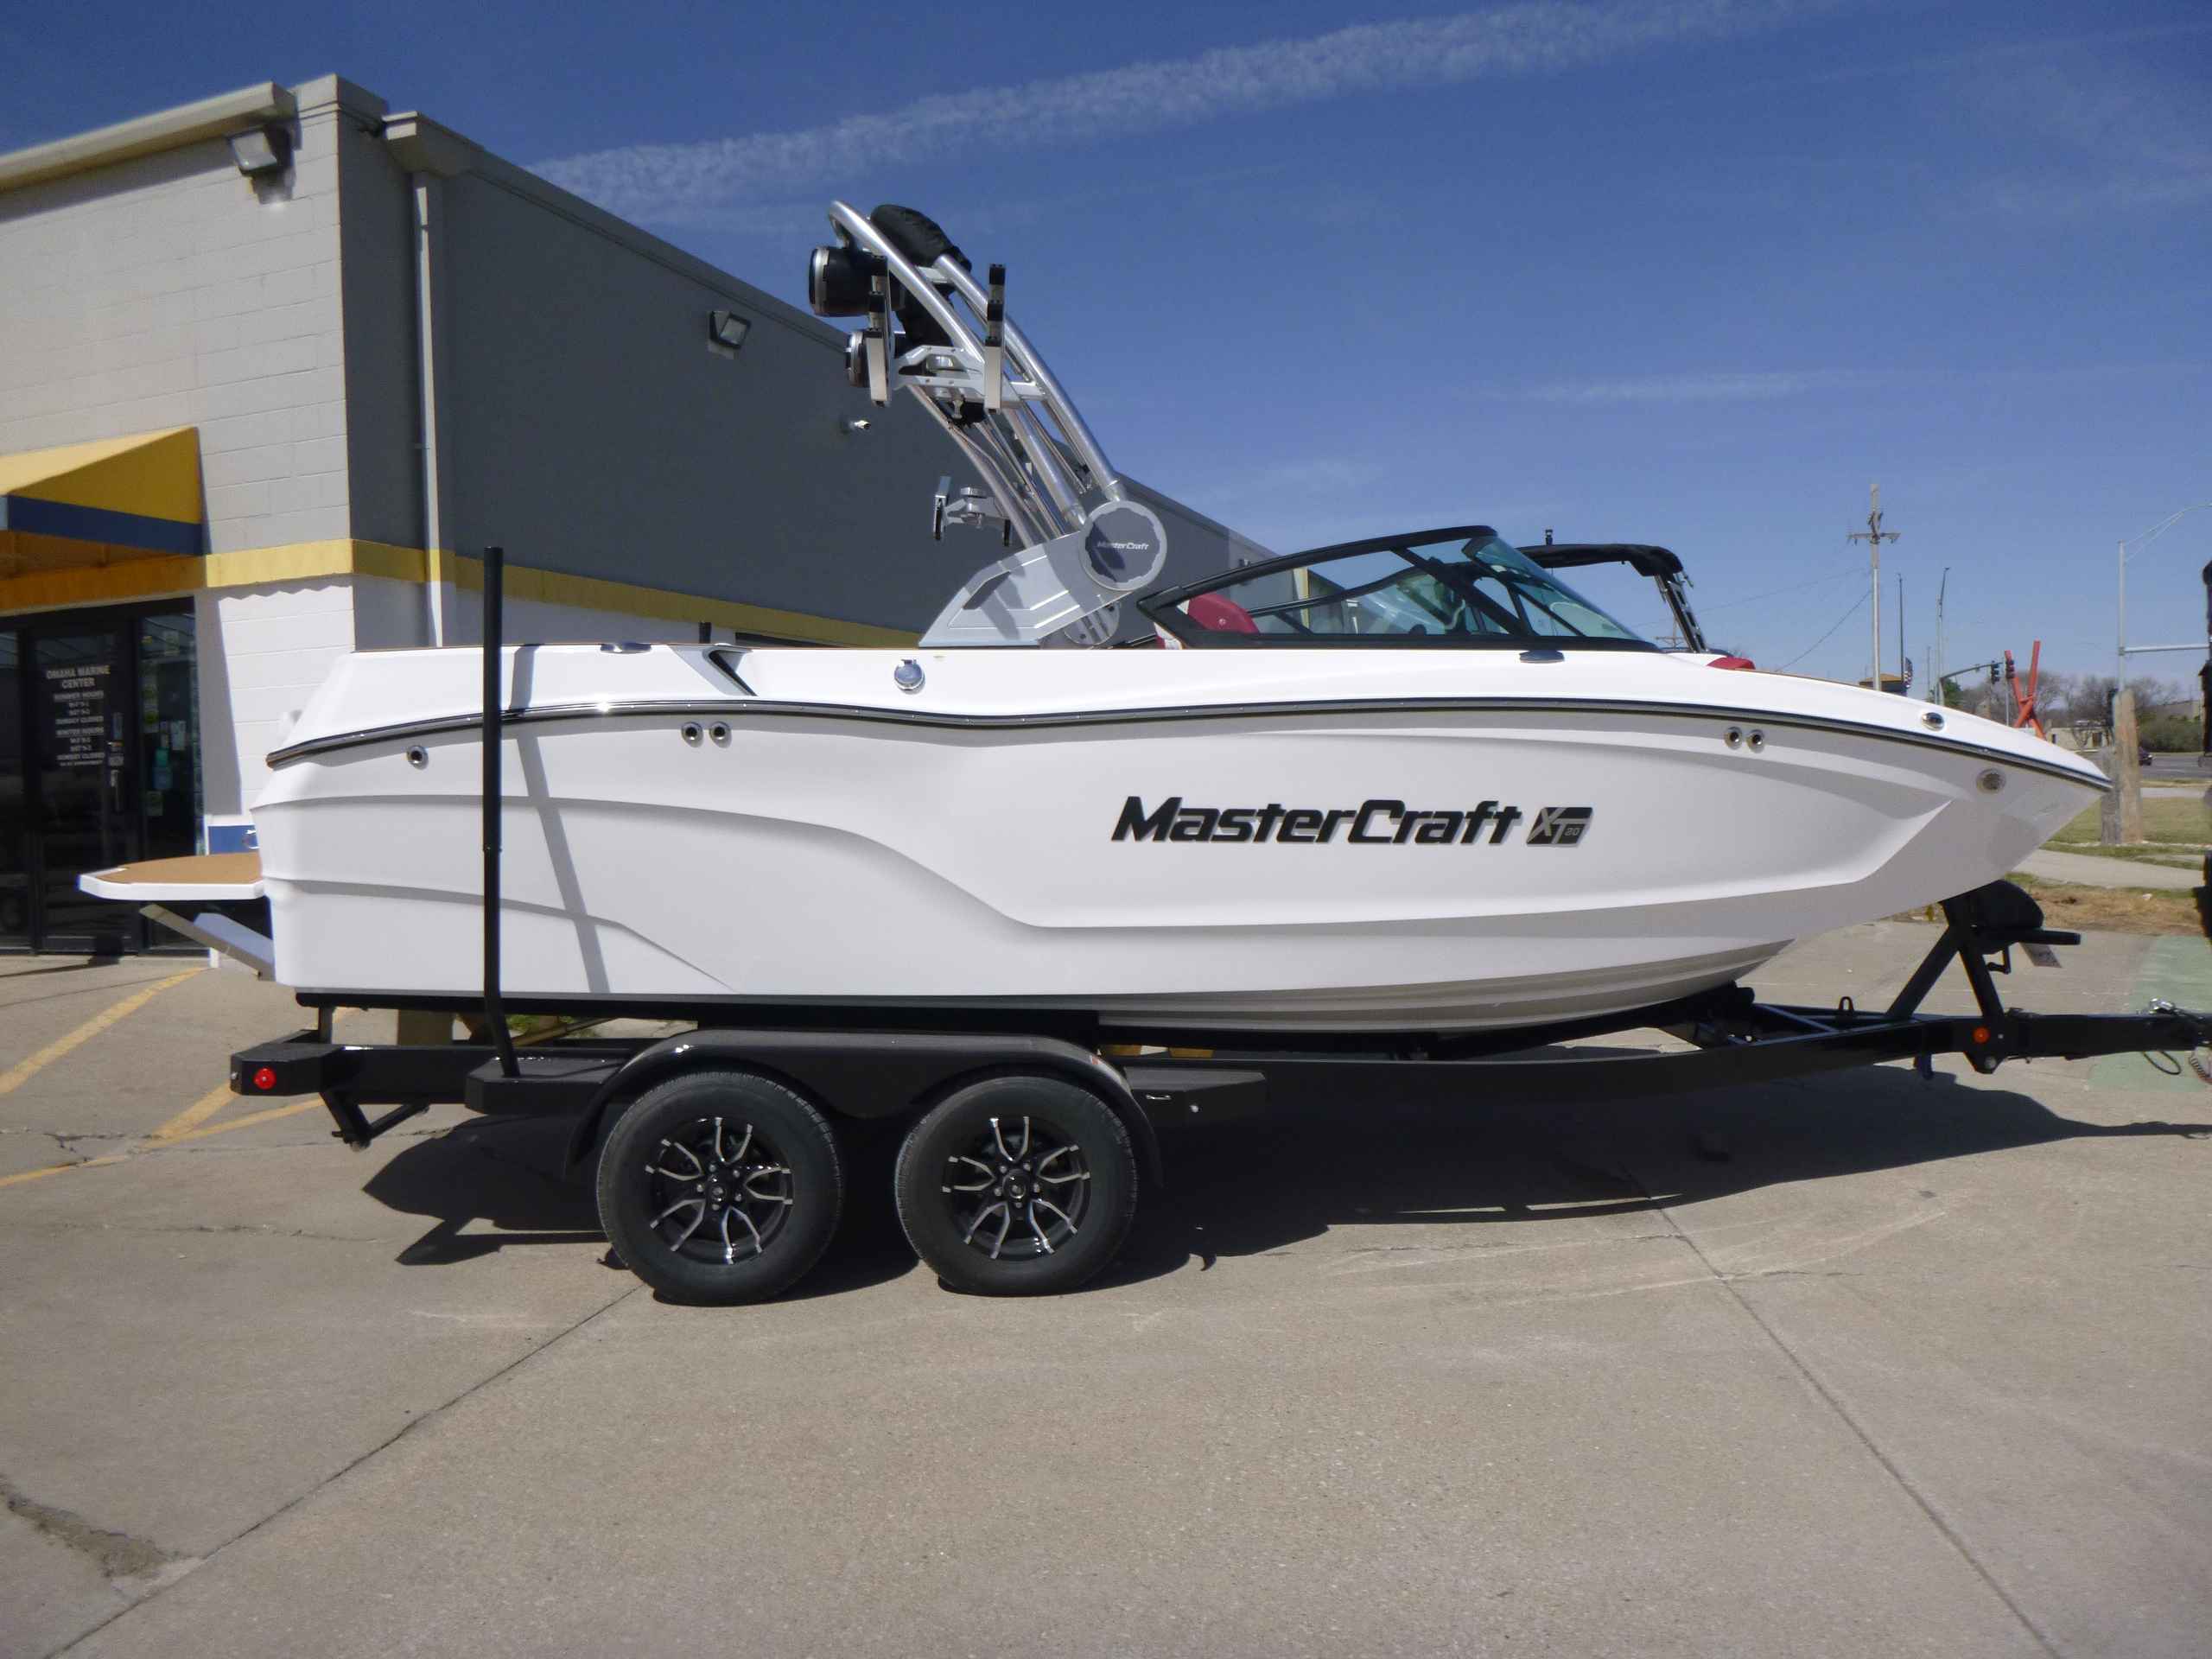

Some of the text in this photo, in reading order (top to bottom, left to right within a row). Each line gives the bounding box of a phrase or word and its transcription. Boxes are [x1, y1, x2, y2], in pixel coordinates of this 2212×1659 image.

[46, 665, 111, 679] OMAHA MARINE
[61, 678, 95, 689] CENTER
[1111, 796, 1522, 844] MasterCraft
